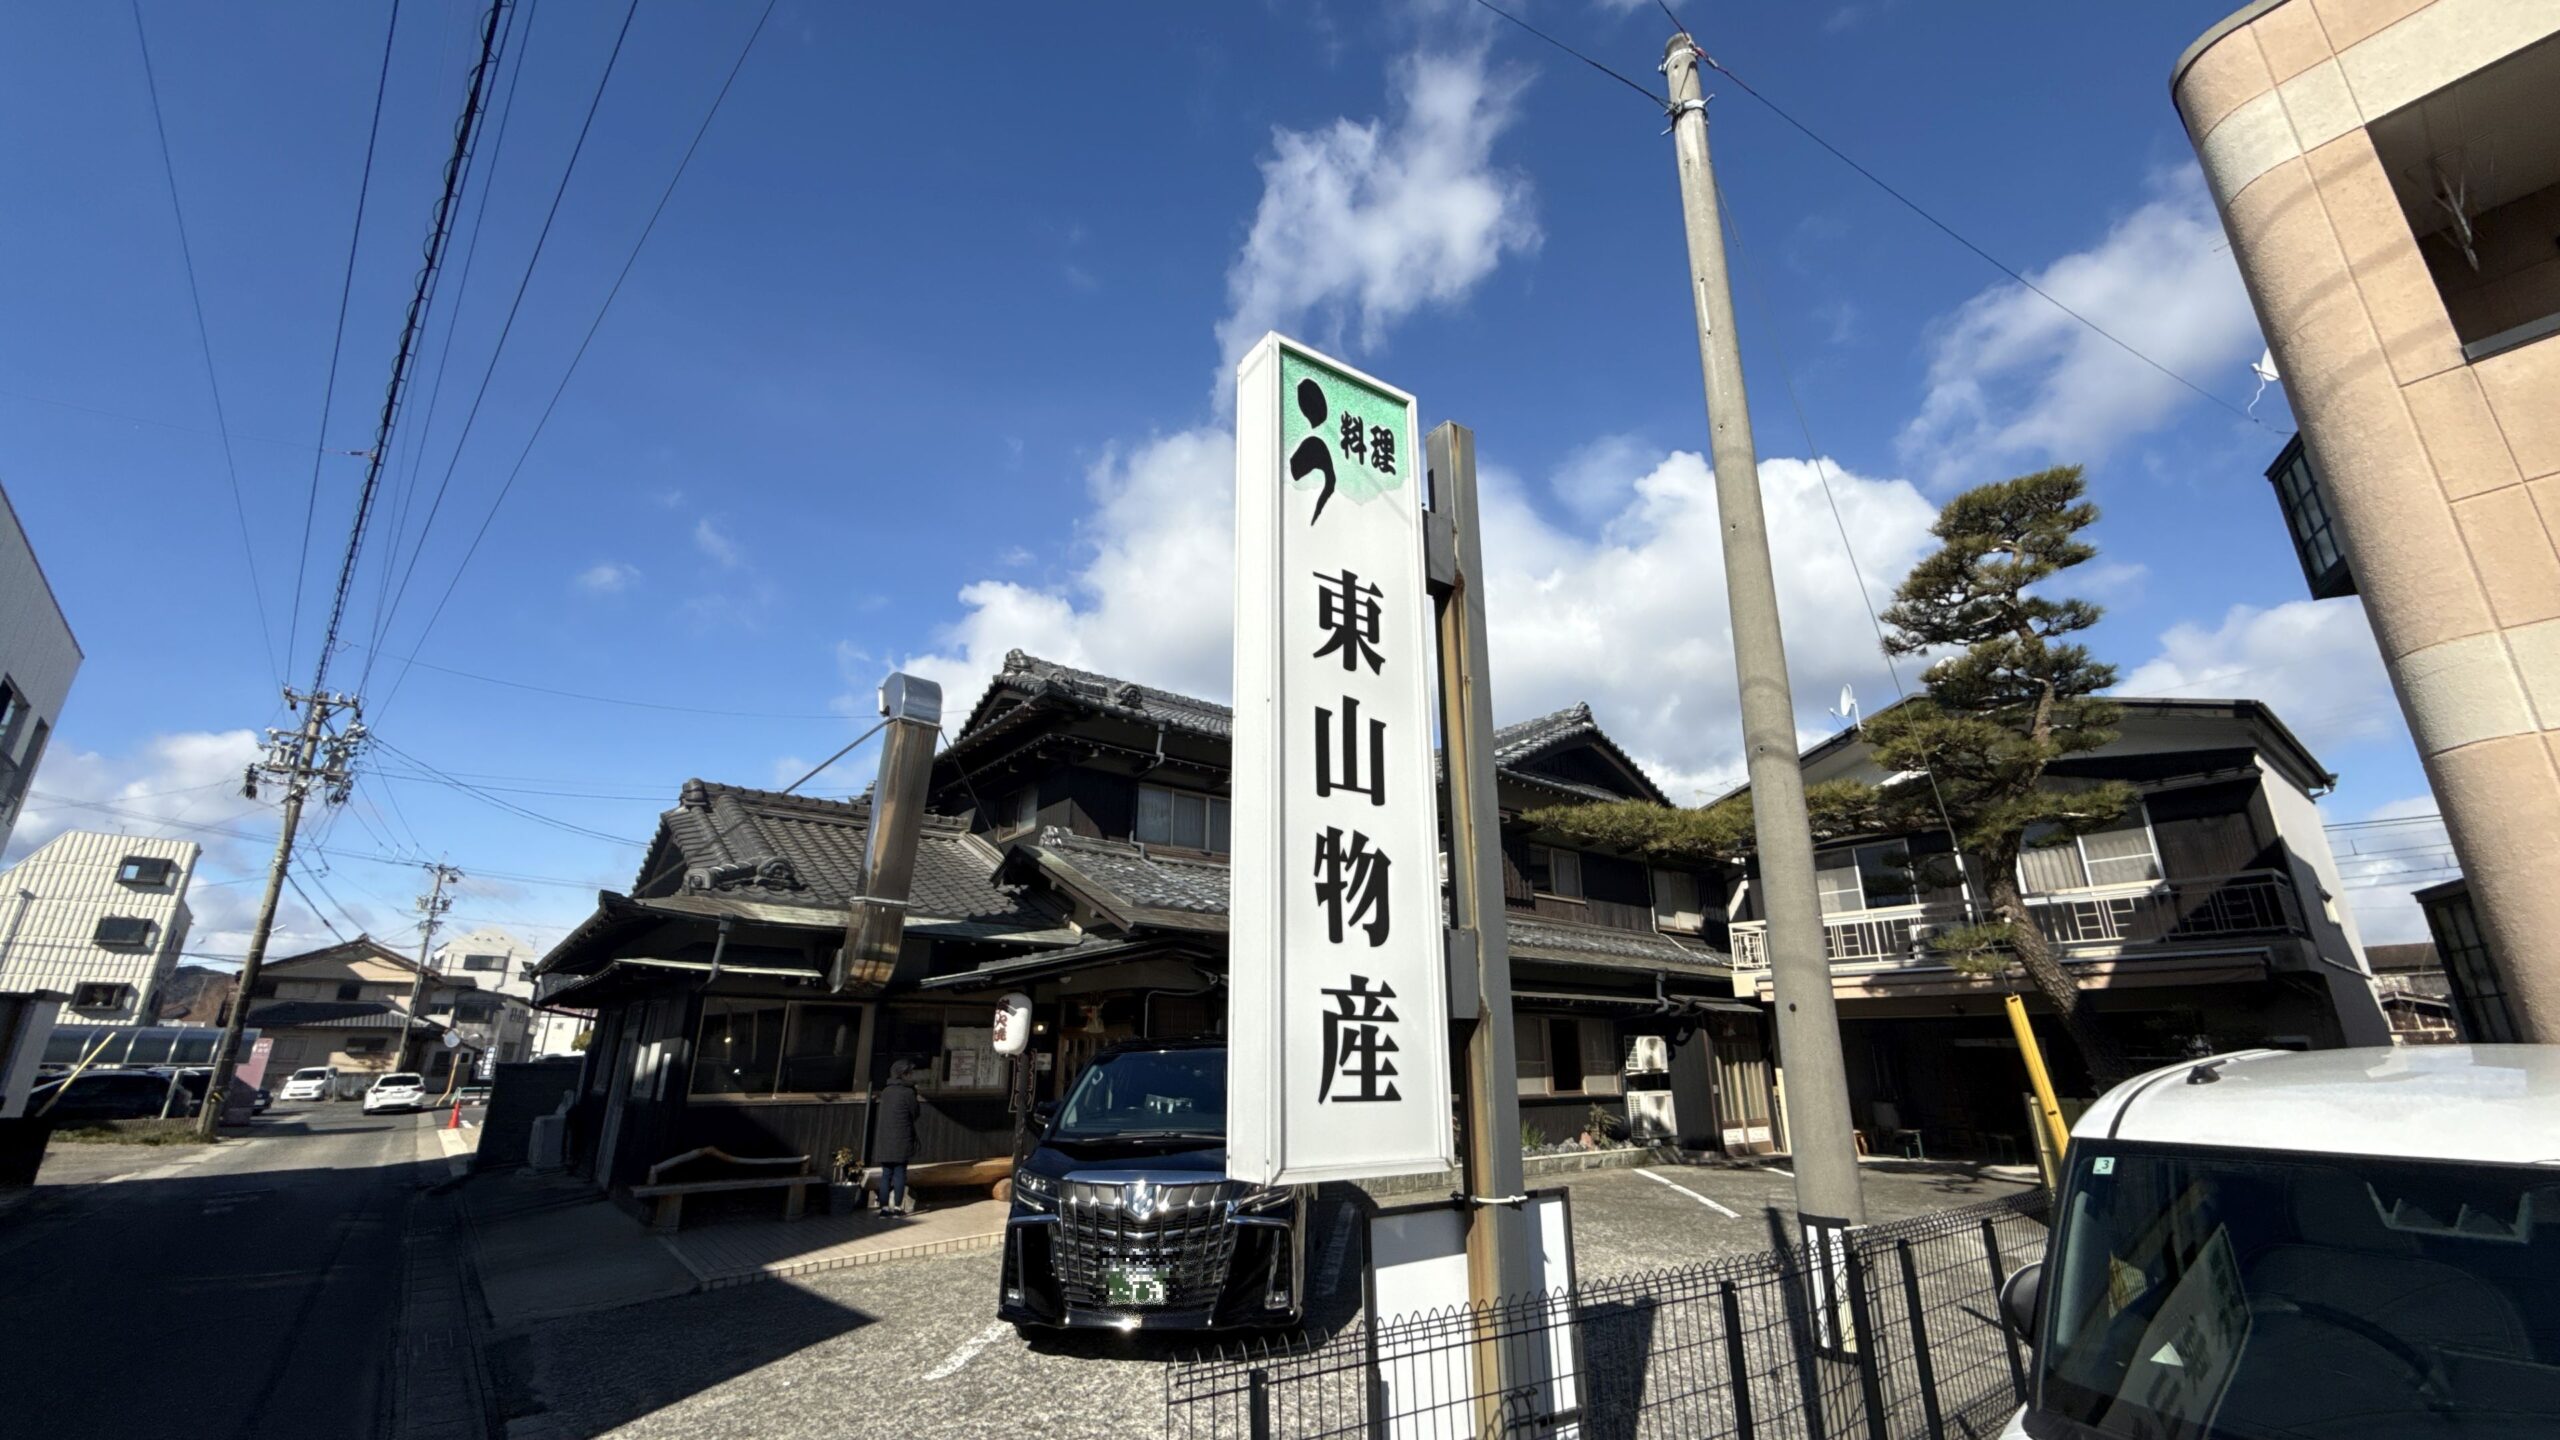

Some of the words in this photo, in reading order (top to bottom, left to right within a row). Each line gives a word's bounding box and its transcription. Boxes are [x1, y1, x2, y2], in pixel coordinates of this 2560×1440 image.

[1340, 410, 1396, 476] 料理
[1314, 570, 1401, 1104] 東山物産
[2101, 1159, 2110, 1170] 3
